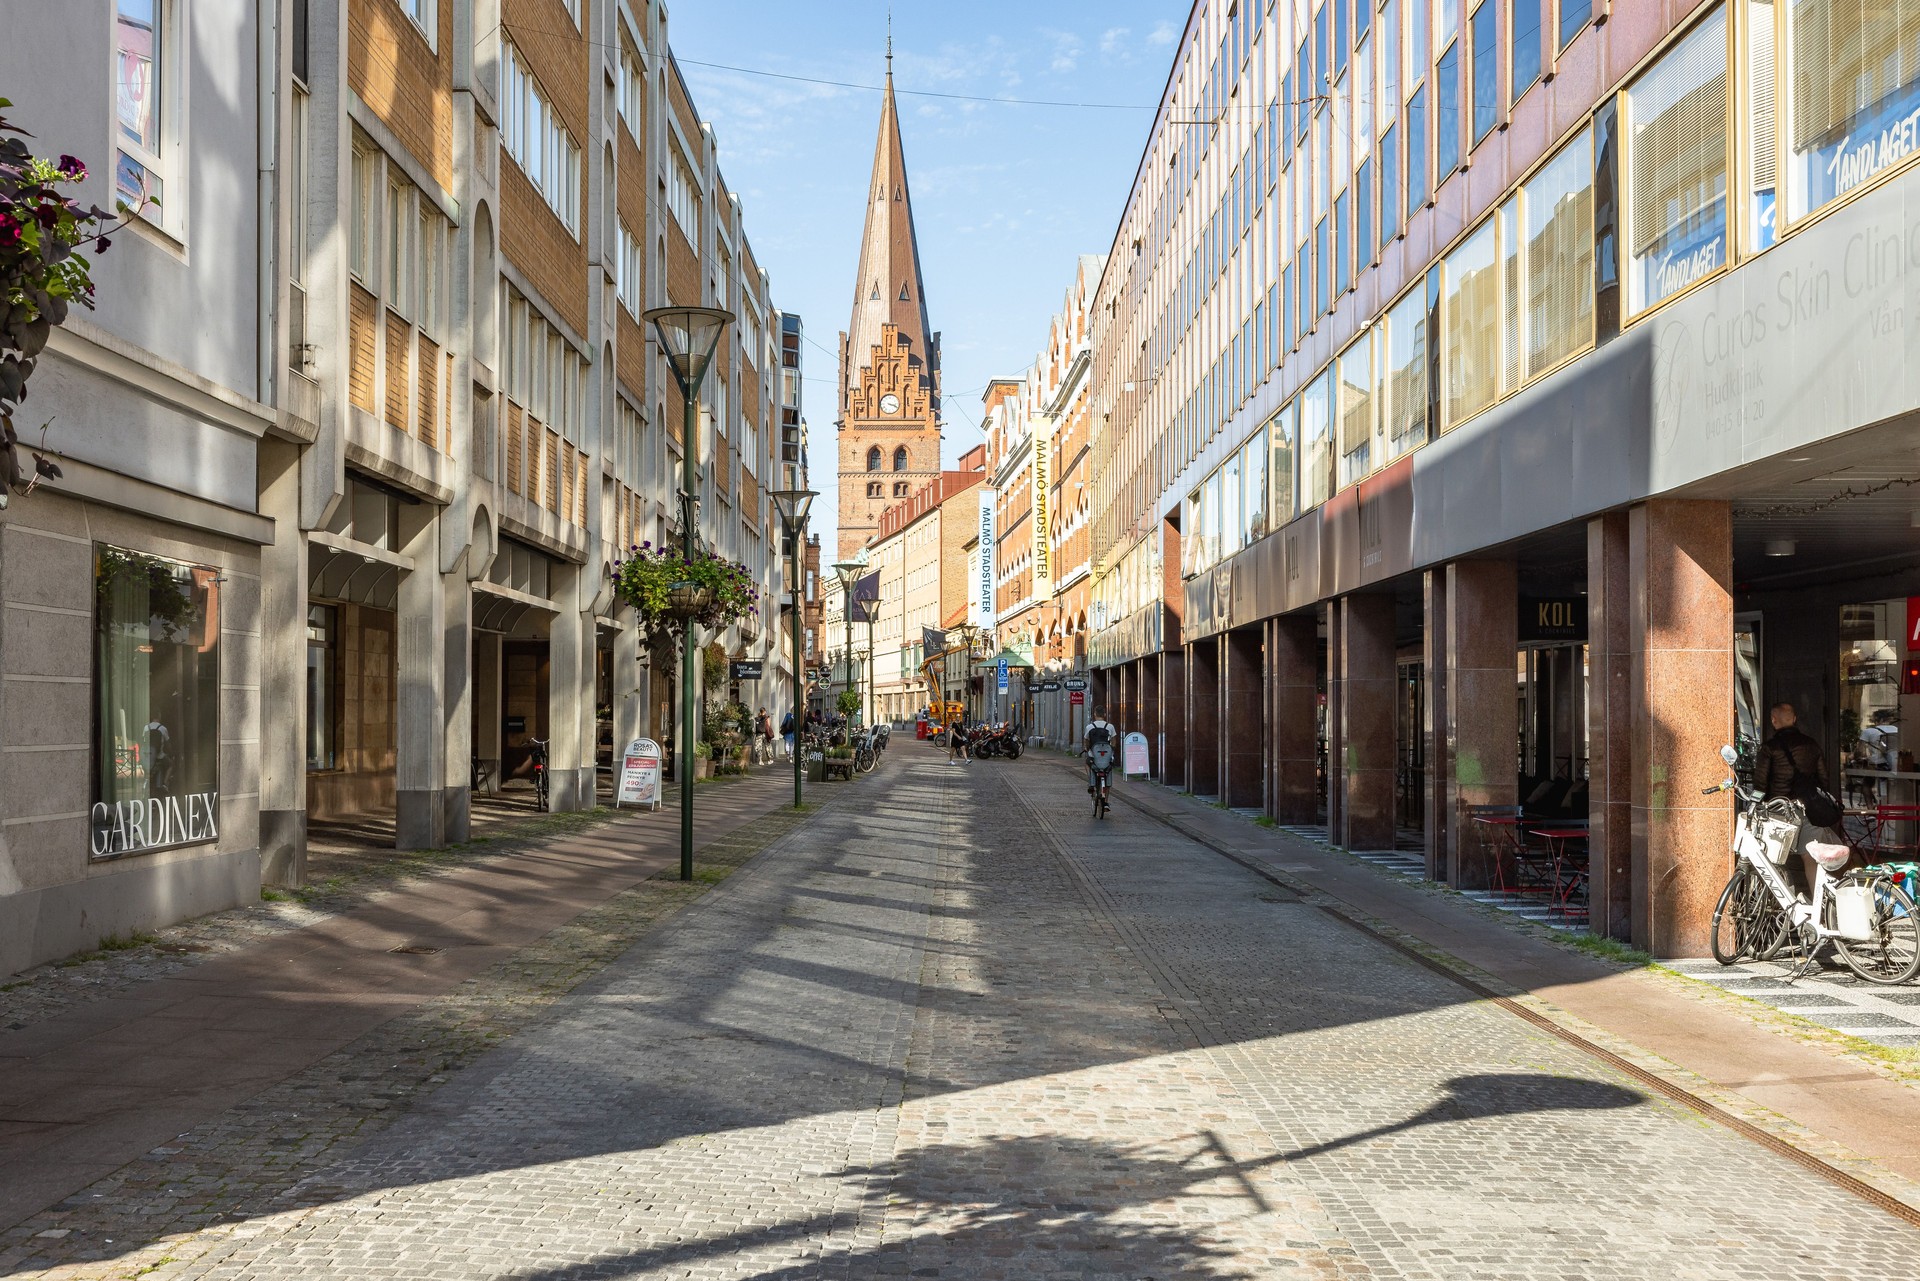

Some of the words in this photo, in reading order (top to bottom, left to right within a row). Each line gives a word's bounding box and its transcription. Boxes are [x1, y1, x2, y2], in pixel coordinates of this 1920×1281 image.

[1827, 107, 1920, 196] TANDLAGET
[1656, 236, 1720, 298] TANDLAGET
[1702, 303, 1767, 367] Curos
[1776, 261, 1830, 332] Skin
[1869, 300, 1904, 339] Vån
[1704, 360, 1764, 410] Hudklinik
[1753, 399, 1764, 421] 20
[1036, 439, 1049, 490] MALMÖ
[982, 507, 993, 546] MALMÖ
[1036, 492, 1048, 579] STADSTEATER
[982, 548, 991, 613] STADSTEATER
[1539, 602, 1575, 626] KOL
[91, 791, 218, 855] GARDINEX
